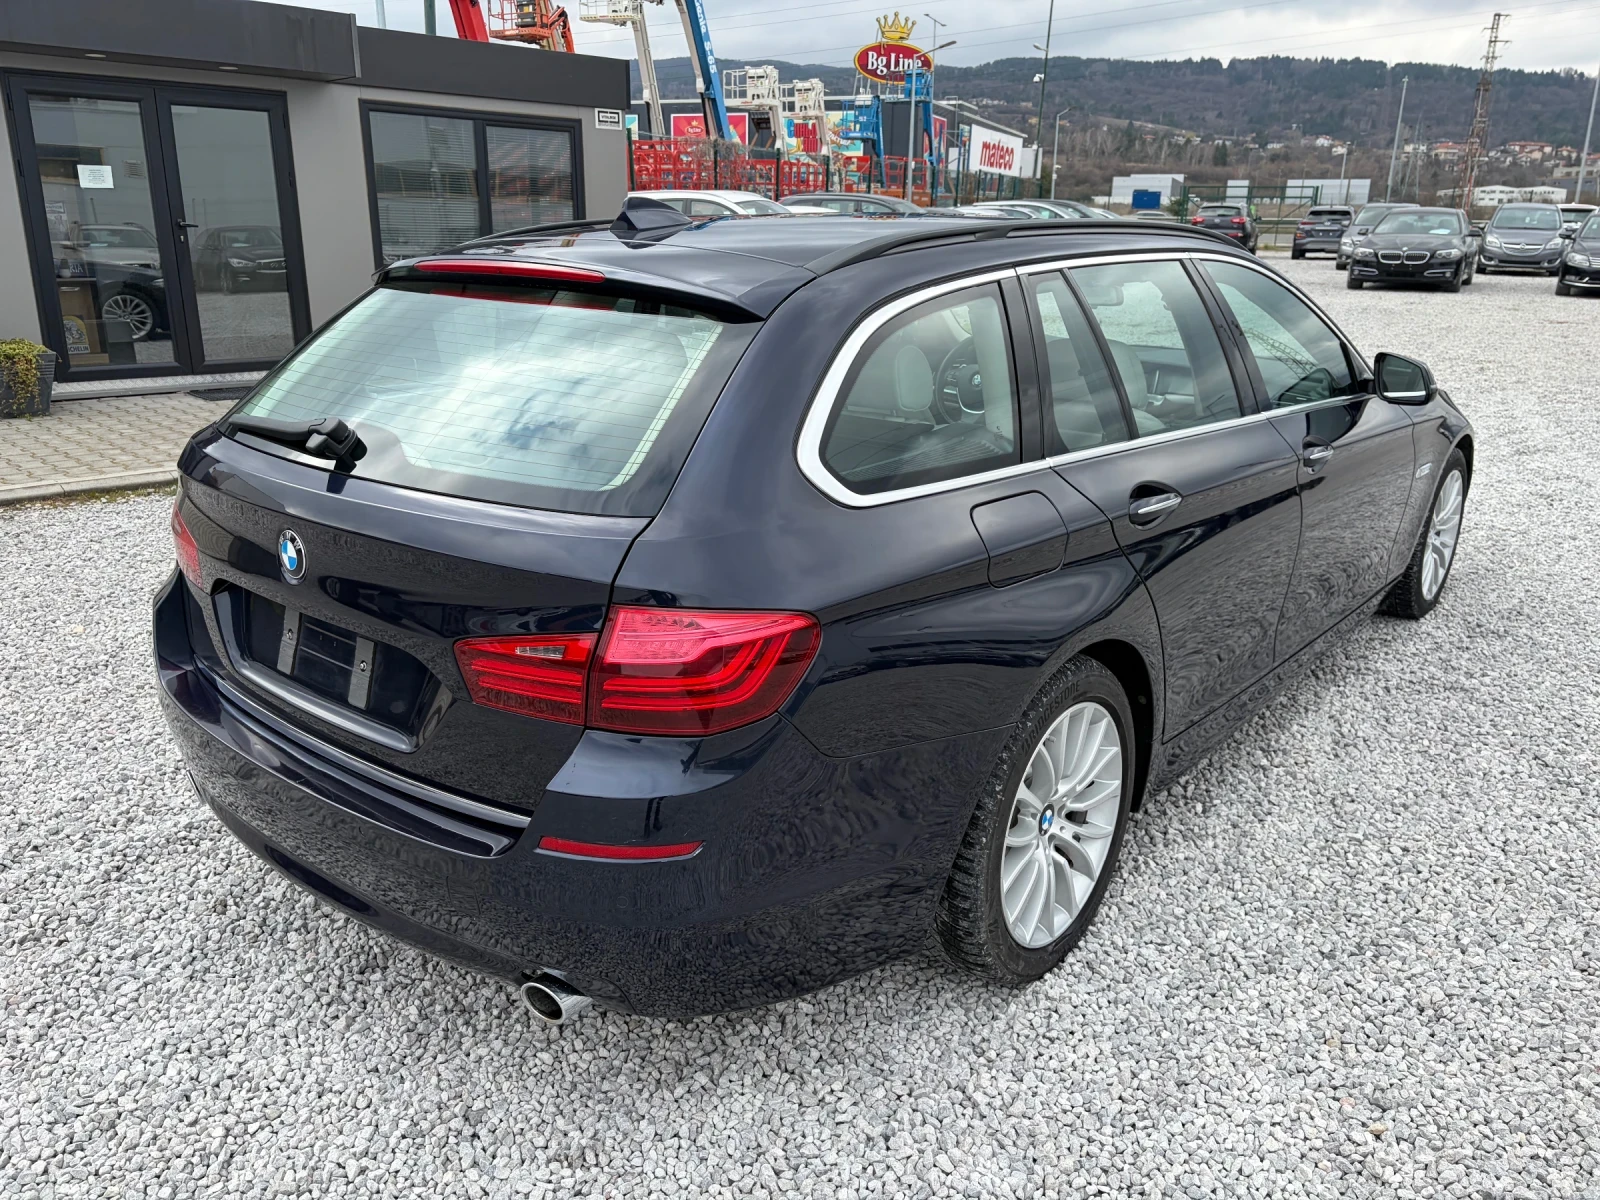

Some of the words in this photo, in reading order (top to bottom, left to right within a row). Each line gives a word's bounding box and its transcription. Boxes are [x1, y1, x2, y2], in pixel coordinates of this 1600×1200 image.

[704, 41, 717, 73] S-65
[867, 51, 887, 75] Bg
[889, 52, 922, 71] Line
[979, 139, 1014, 171] mateco
[68, 345, 89, 353] ICHELIN
[1021, 680, 1081, 758] BRIDGESTONE
